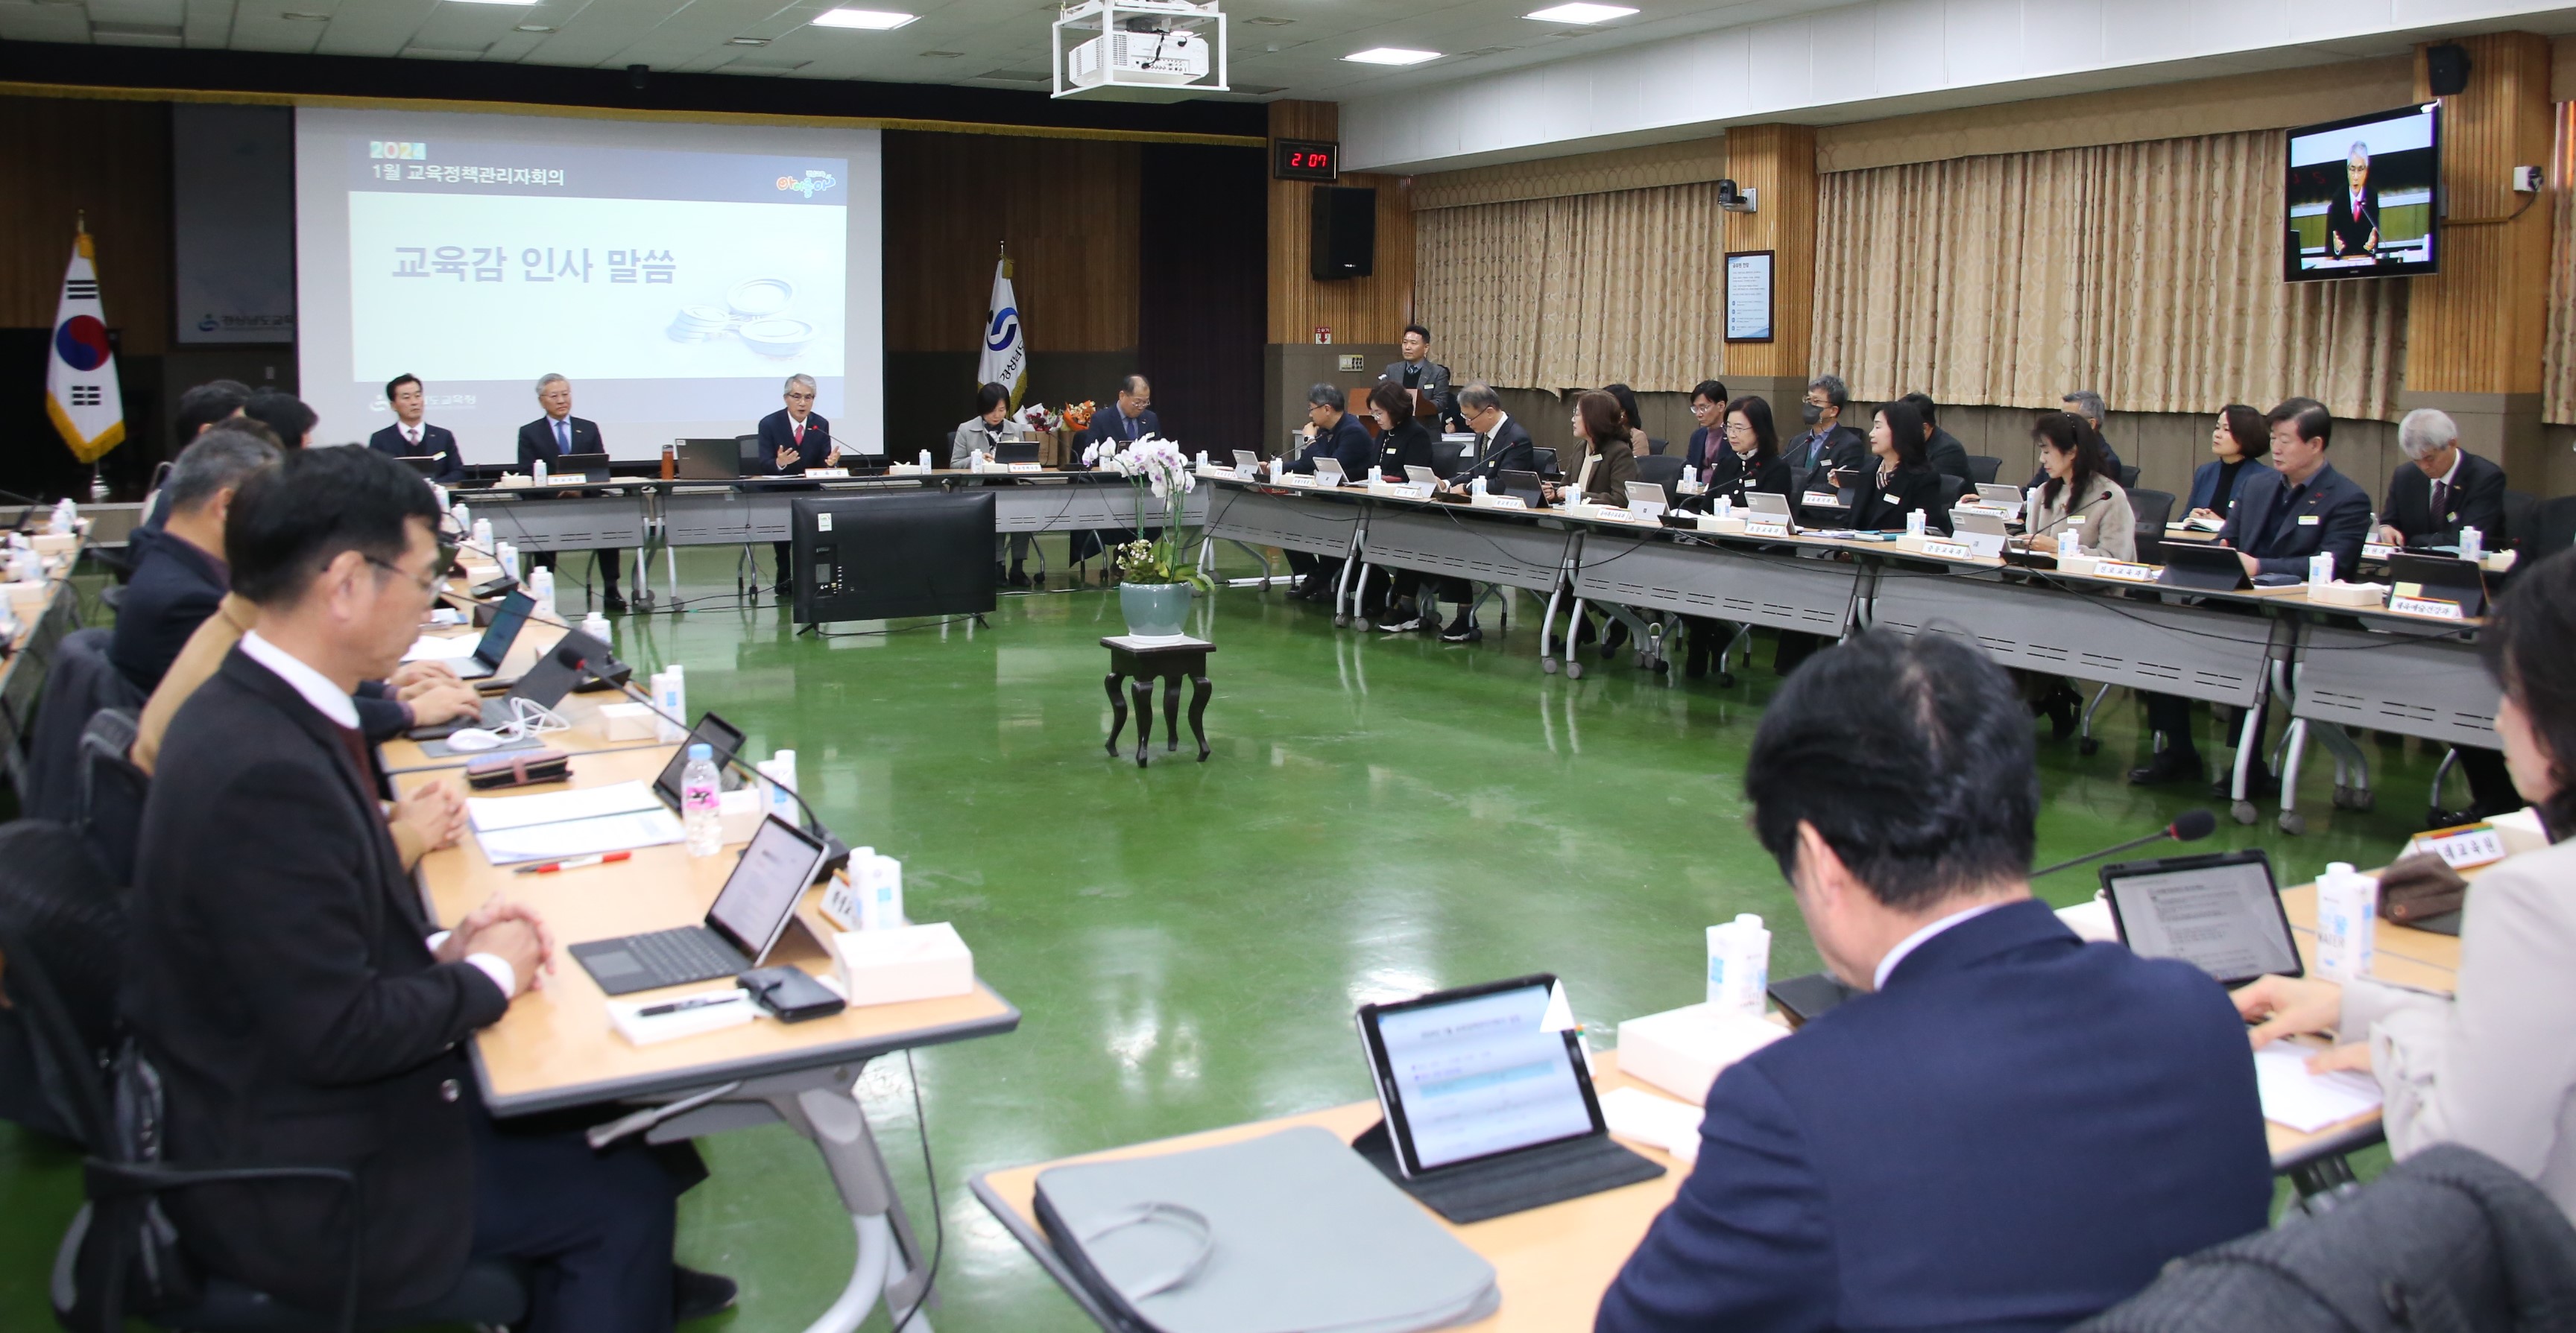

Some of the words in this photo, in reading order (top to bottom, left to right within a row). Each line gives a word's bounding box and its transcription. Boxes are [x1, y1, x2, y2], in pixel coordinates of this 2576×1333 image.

[370, 142, 426, 160] 2024
[1292, 153, 1302, 166] 2
[1308, 153, 1328, 167] 07
[373, 164, 400, 181] 1월
[407, 165, 564, 186] 교육정책관리자회의
[392, 245, 508, 282] 교육감
[521, 247, 593, 283] 인사
[607, 248, 676, 284] 말씀
[425, 394, 477, 405] 도교육청
[2100, 566, 2141, 577] 진로교육과
[2396, 602, 2450, 615] 체육예술건강과
[2442, 837, 2496, 861] 래교육원
